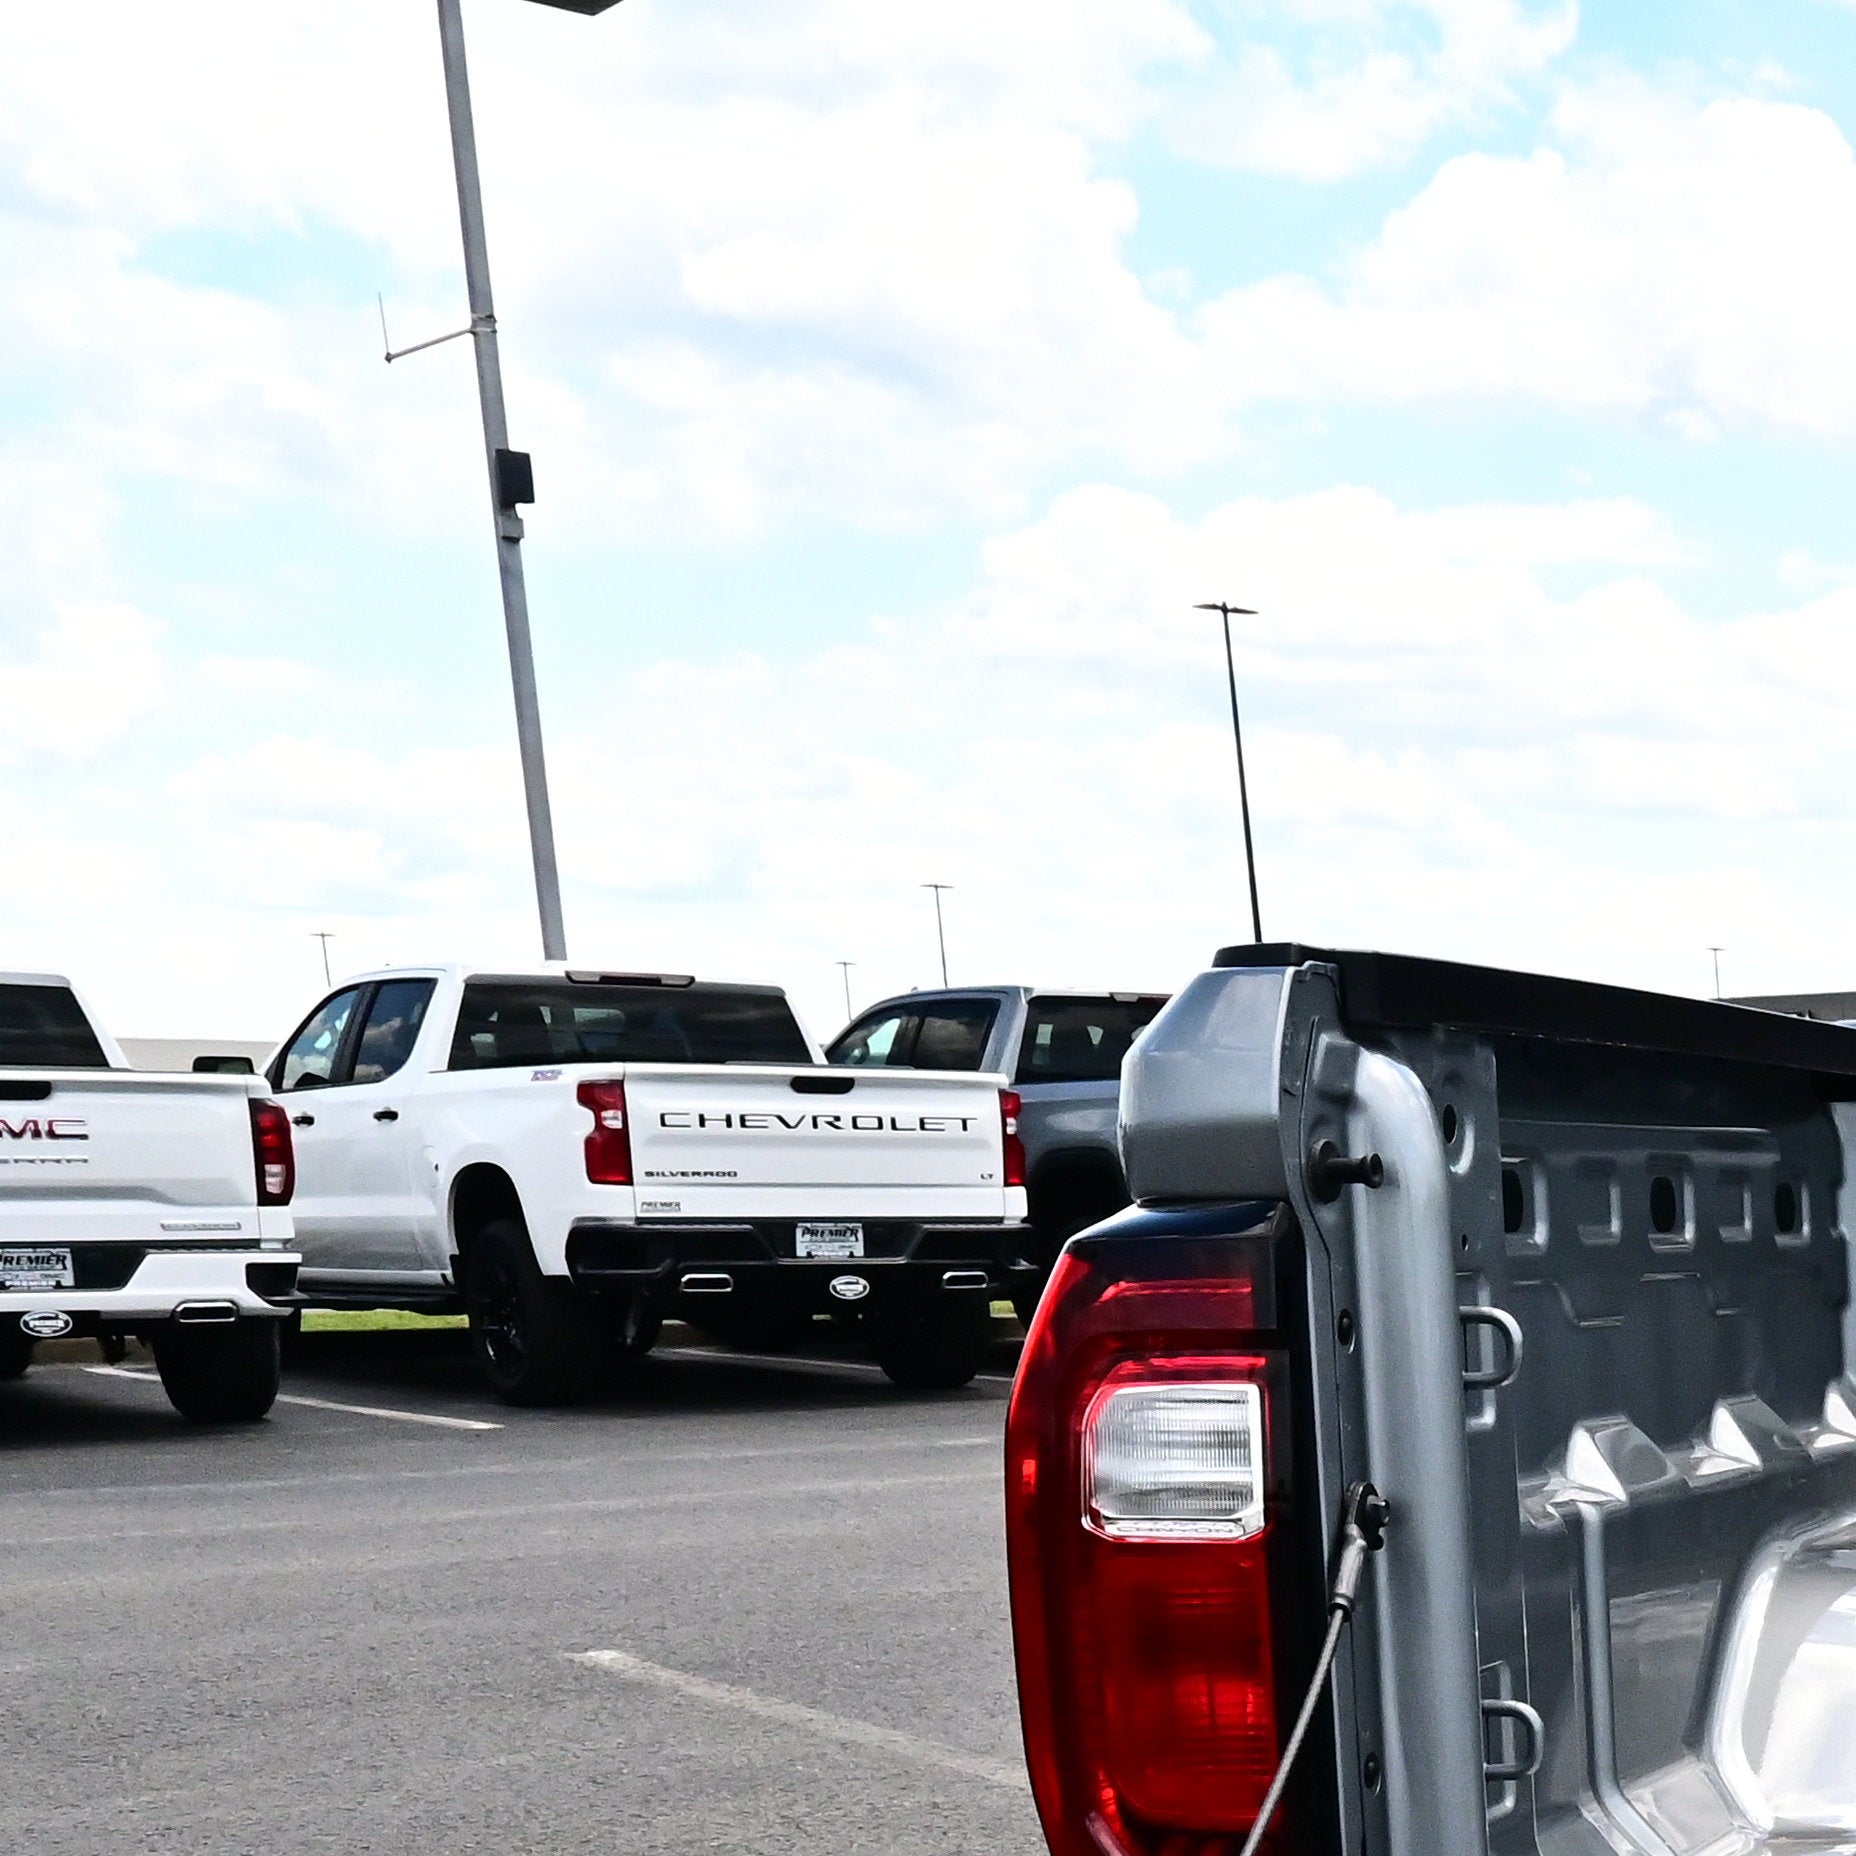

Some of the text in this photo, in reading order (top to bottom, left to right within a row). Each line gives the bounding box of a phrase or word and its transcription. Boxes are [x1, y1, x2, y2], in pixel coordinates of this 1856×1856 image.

[0, 1118, 89, 1140] MC
[659, 1112, 978, 1132] CHEVROLET
[801, 1227, 859, 1242] PREMIER
[0, 1254, 67, 1270] REMIER
